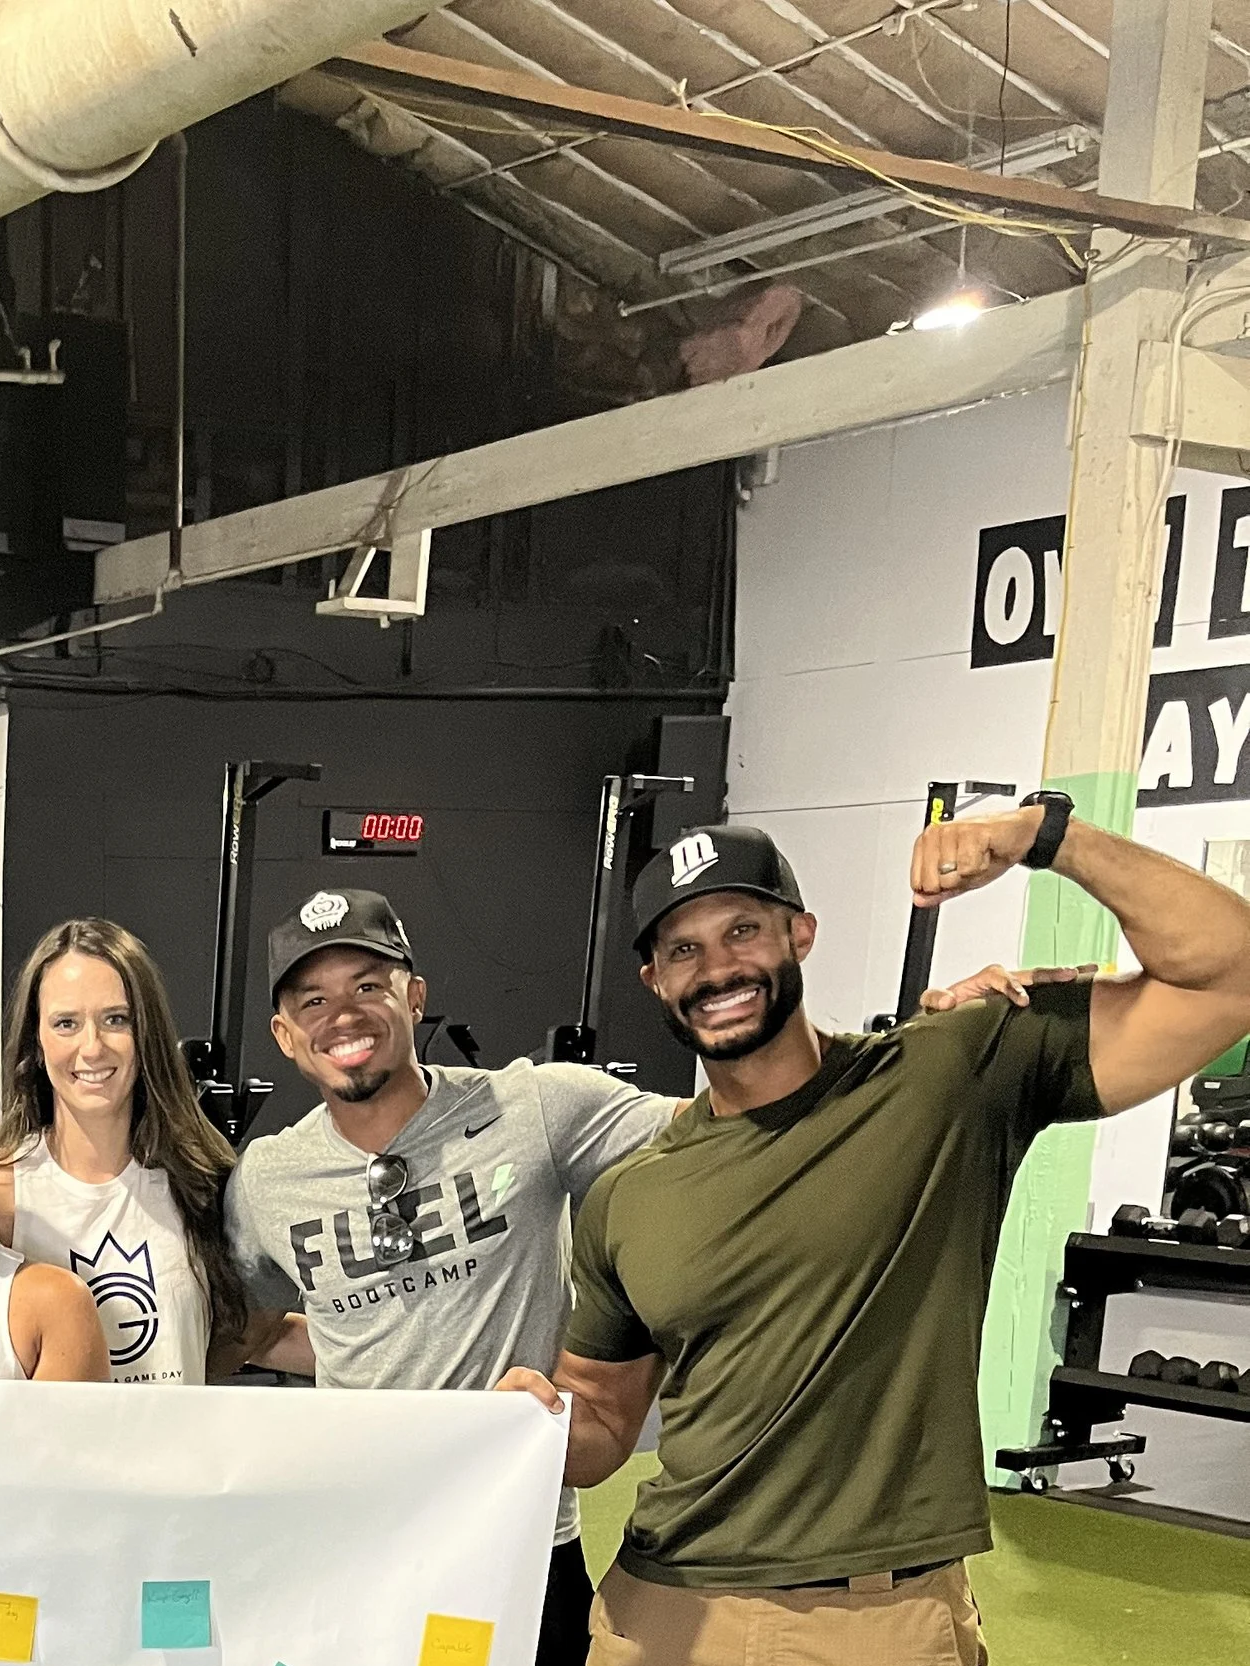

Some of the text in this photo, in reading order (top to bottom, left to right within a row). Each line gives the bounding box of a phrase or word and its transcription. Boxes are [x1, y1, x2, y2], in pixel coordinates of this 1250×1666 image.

[362, 814, 423, 839] 00:00
[332, 1258, 478, 1314] BOOTCAMP
[124, 1373, 157, 1383] GAME
[161, 1370, 183, 1380] DAY
